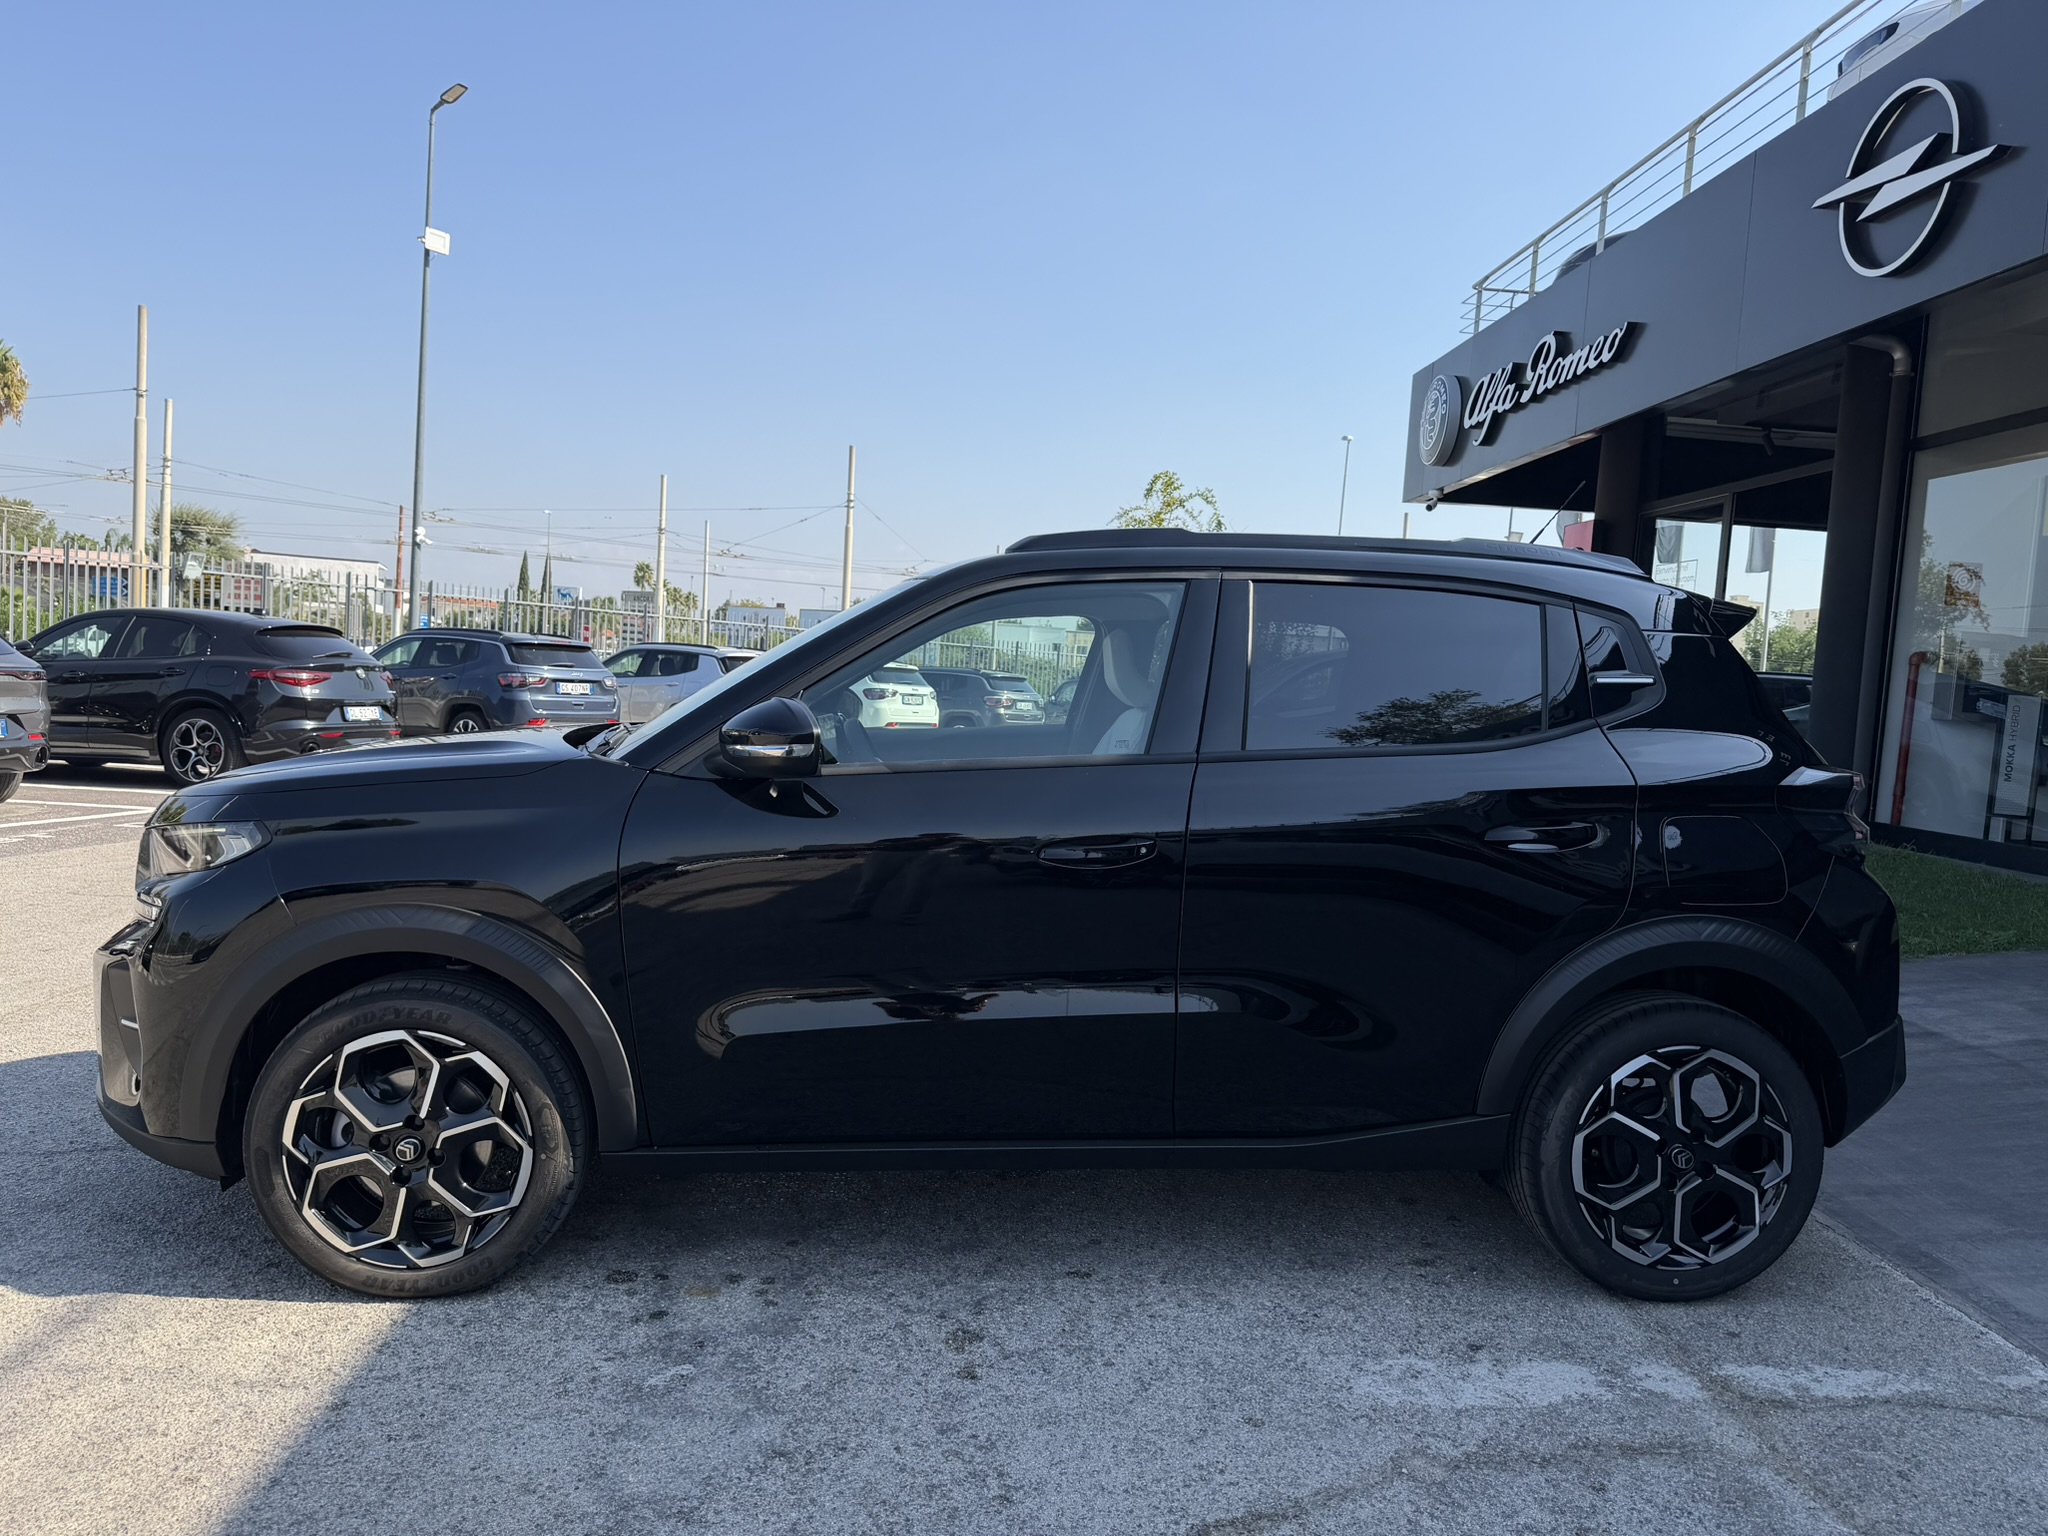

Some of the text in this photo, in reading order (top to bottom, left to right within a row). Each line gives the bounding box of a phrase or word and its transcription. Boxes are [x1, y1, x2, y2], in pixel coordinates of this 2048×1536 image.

[1464, 362, 1518, 446] Alfa
[1520, 322, 1629, 403] Romeo
[2003, 704, 2021, 783] MOKKA HYBRID
